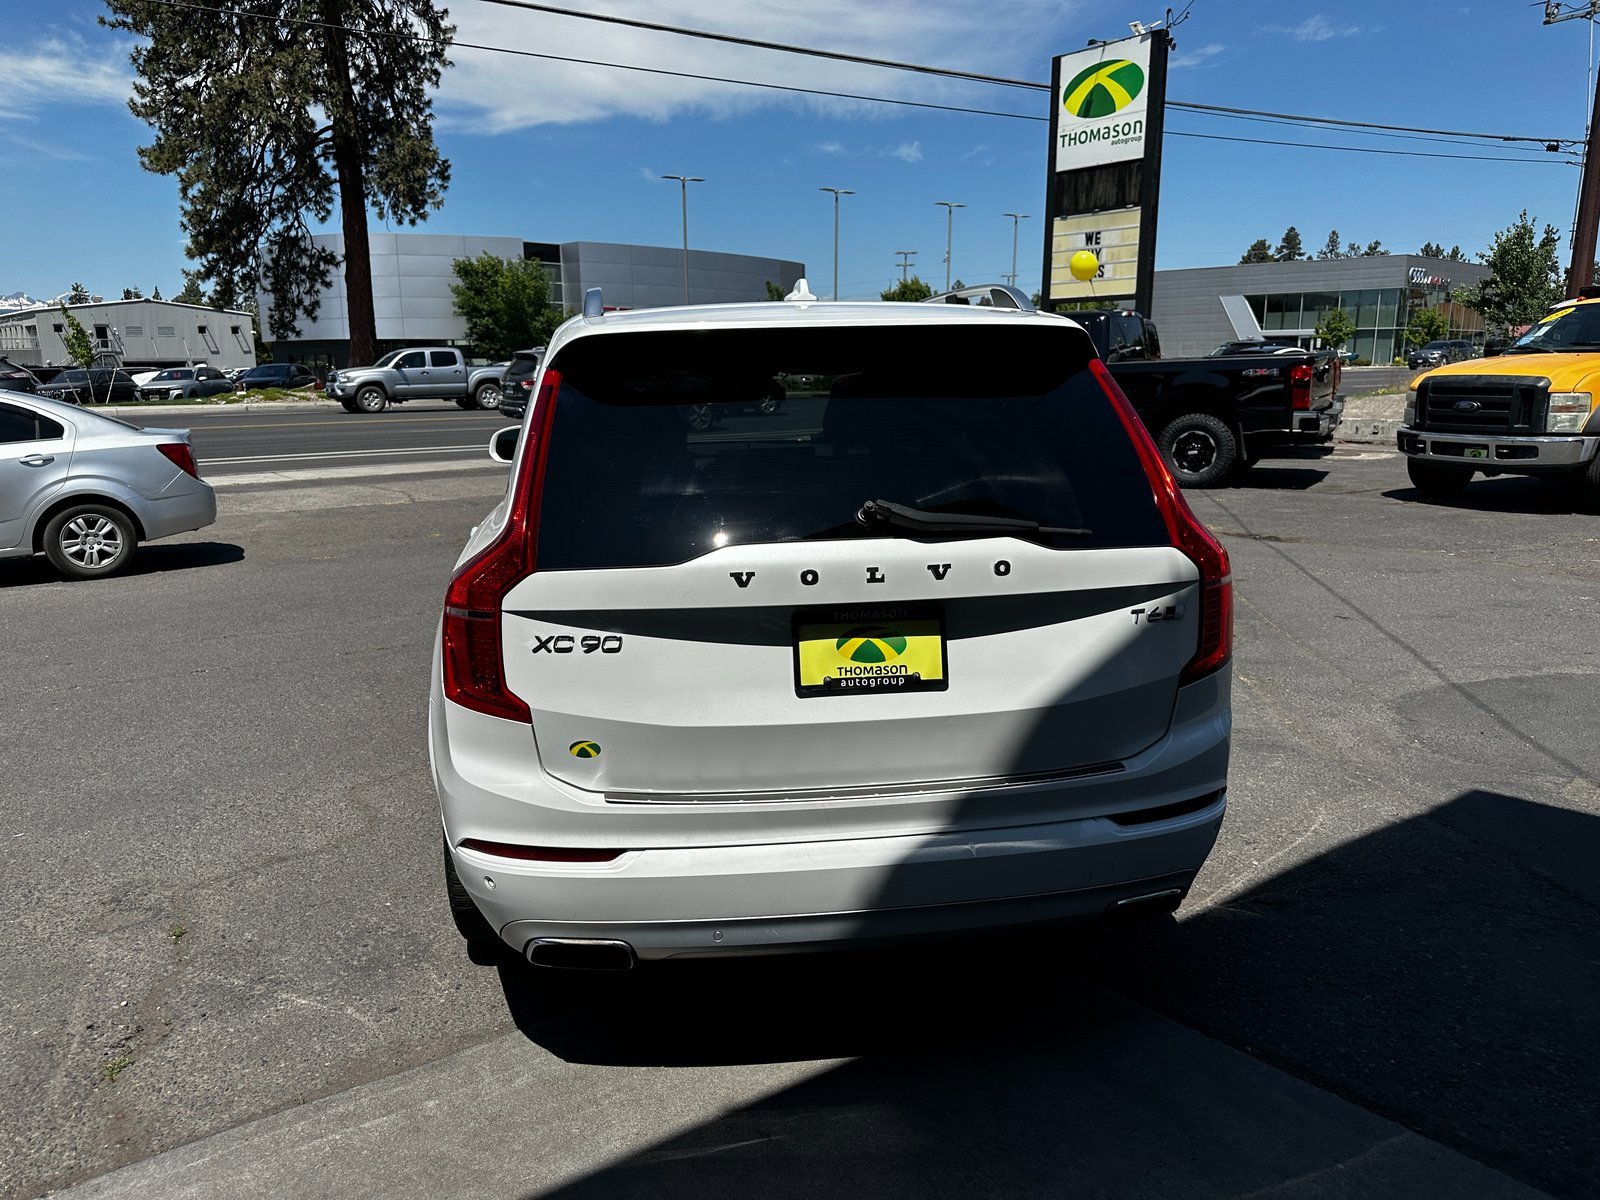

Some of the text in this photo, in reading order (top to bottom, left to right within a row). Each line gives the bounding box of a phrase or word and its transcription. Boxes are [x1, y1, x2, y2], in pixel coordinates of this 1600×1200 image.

[1059, 119, 1143, 148] THOMason
[1110, 135, 1143, 146] autogroup
[1085, 231, 1102, 246] WE
[730, 559, 1011, 588] VOLVO
[837, 664, 908, 677] THOMason
[840, 676, 905, 688] autogroup
